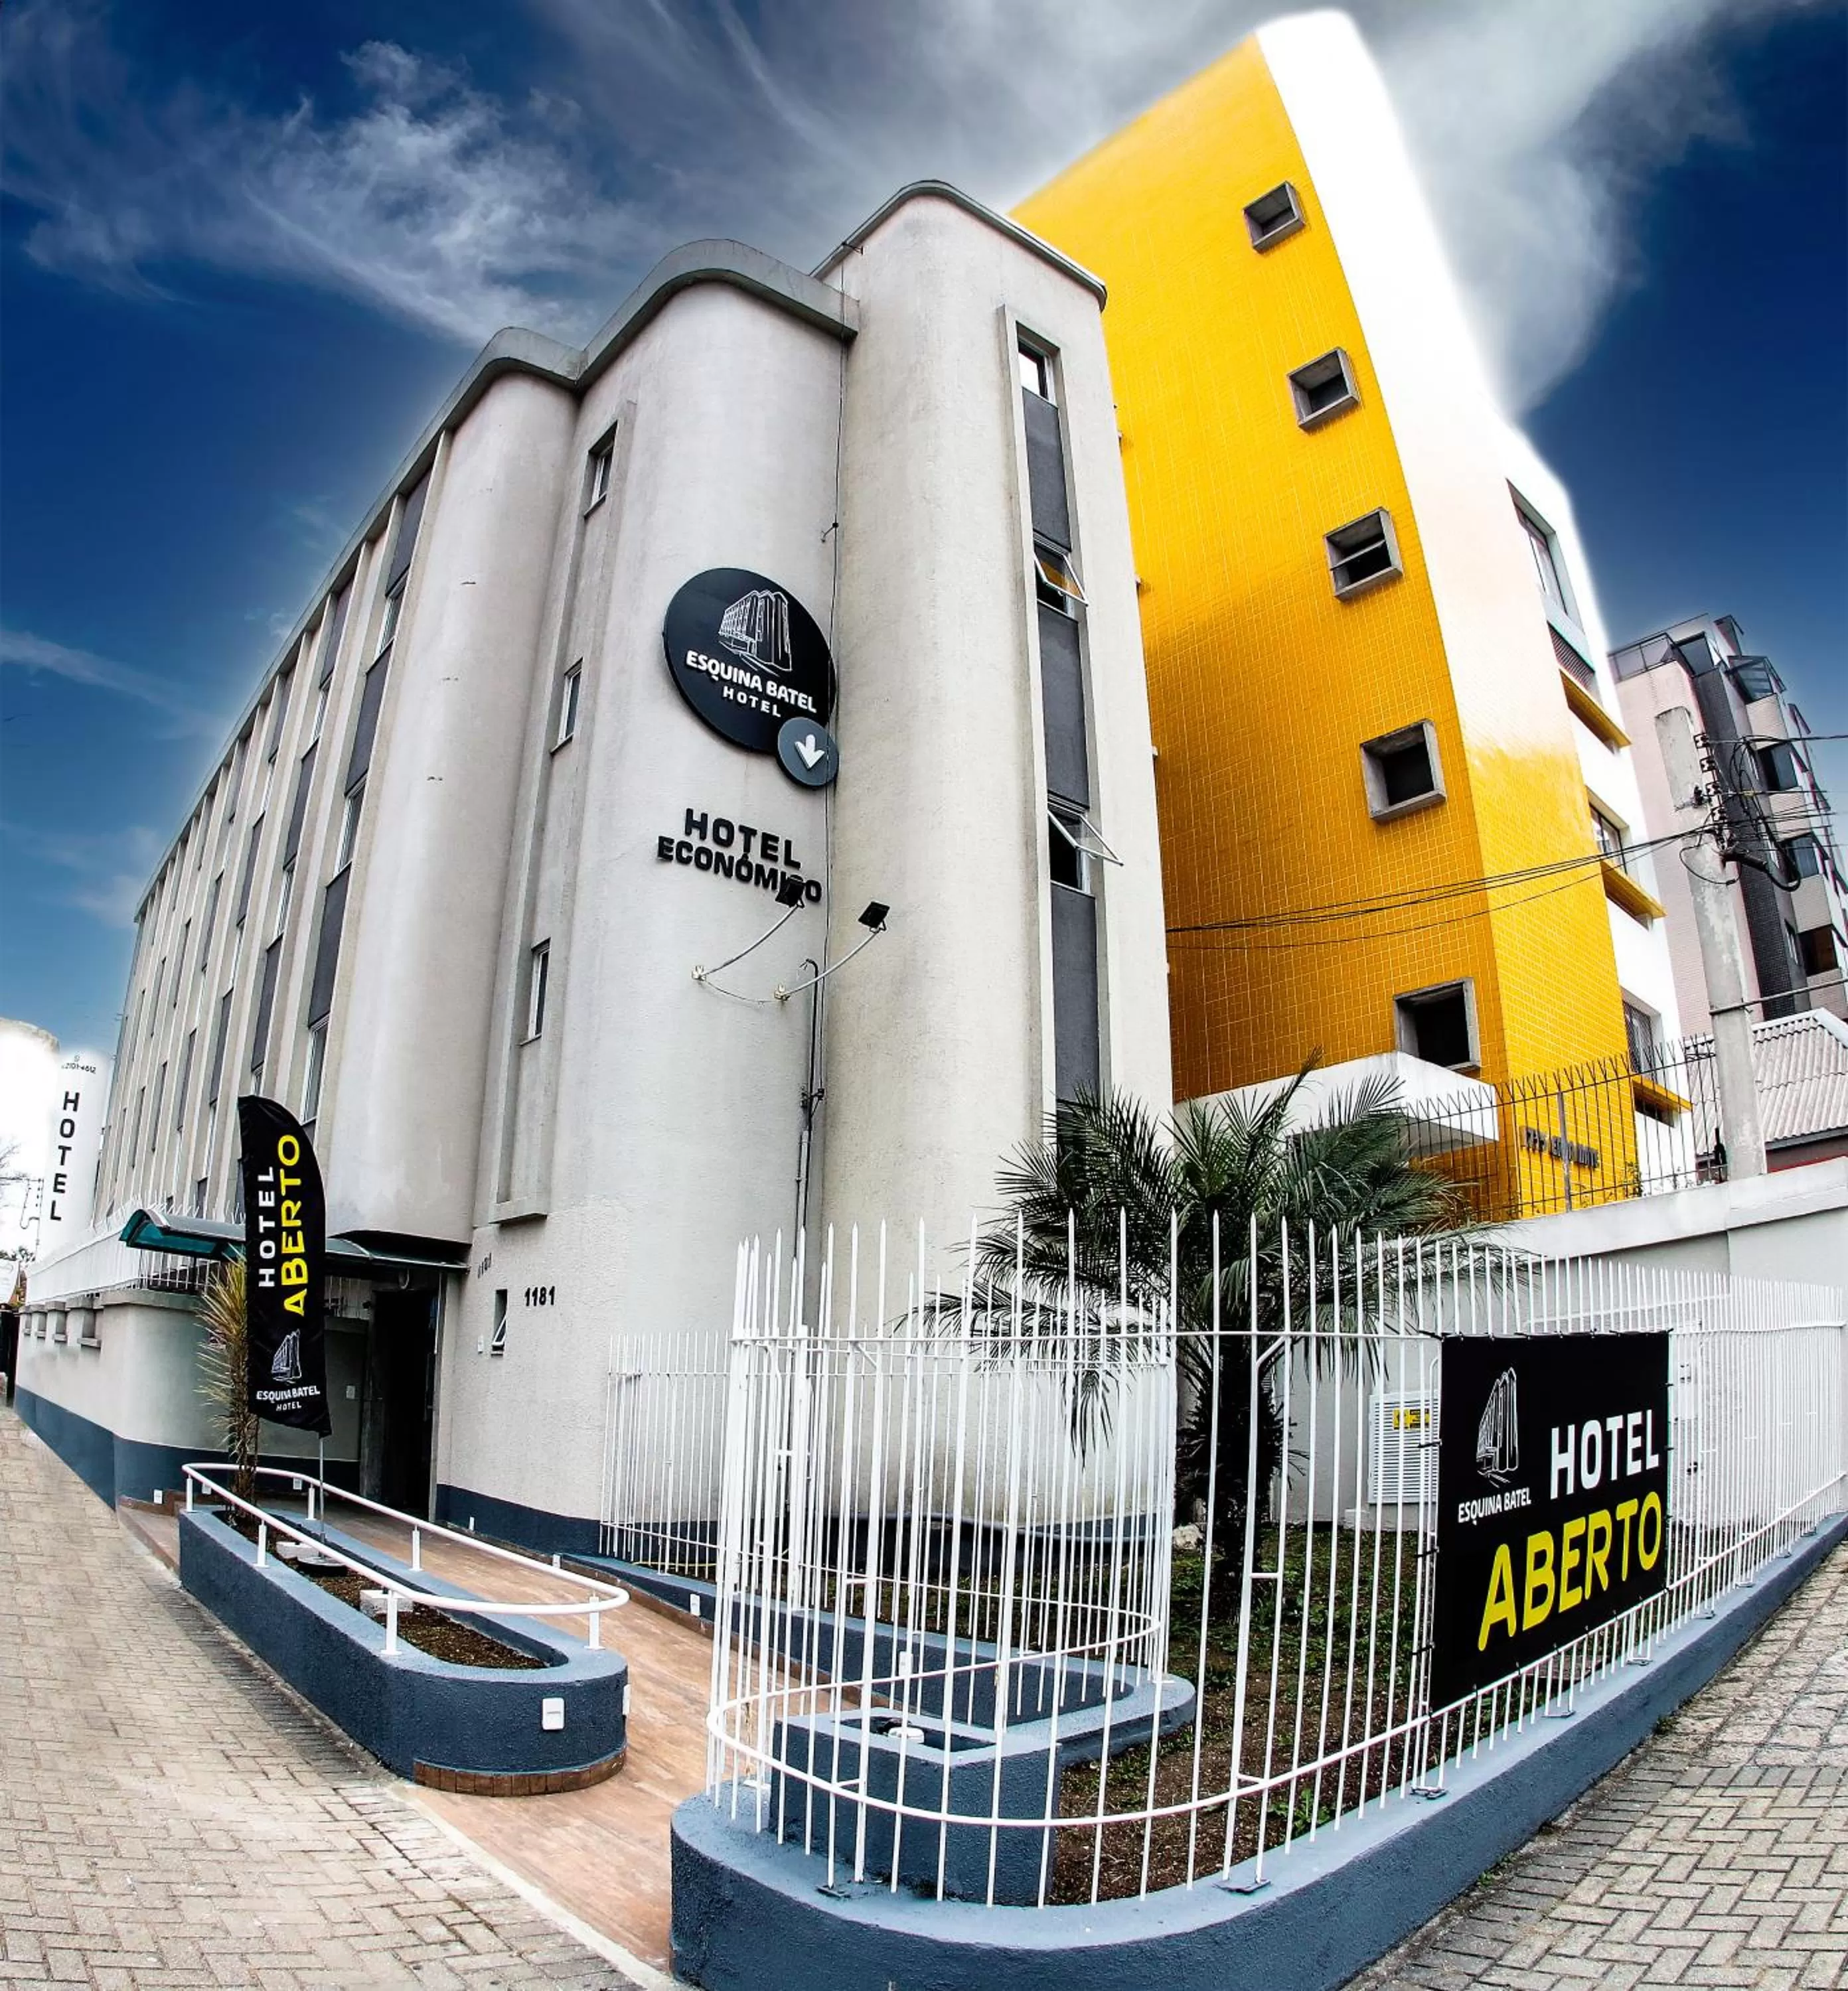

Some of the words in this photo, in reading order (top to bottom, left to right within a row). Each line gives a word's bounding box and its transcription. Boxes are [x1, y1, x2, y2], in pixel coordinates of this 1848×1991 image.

[686, 649, 763, 692] ESQUINA
[766, 682, 816, 714] BATEL
[723, 686, 781, 717] HOTEL
[657, 836, 822, 903] ECONÔMIO
[684, 808, 801, 870] HOTEL
[50, 1091, 80, 1221] HOTEL
[258, 1167, 275, 1287] HOTEL
[277, 1135, 309, 1316] ABERTO
[524, 1286, 556, 1307] 1181
[275, 1401, 302, 1412] HOTEL
[291, 1385, 321, 1398] BATEL
[1550, 1409, 1659, 1500] HOTEL
[1458, 1494, 1502, 1526] ESQUINA
[1503, 1487, 1531, 1512] BATEL
[1478, 1491, 1661, 1651] ABERTO
